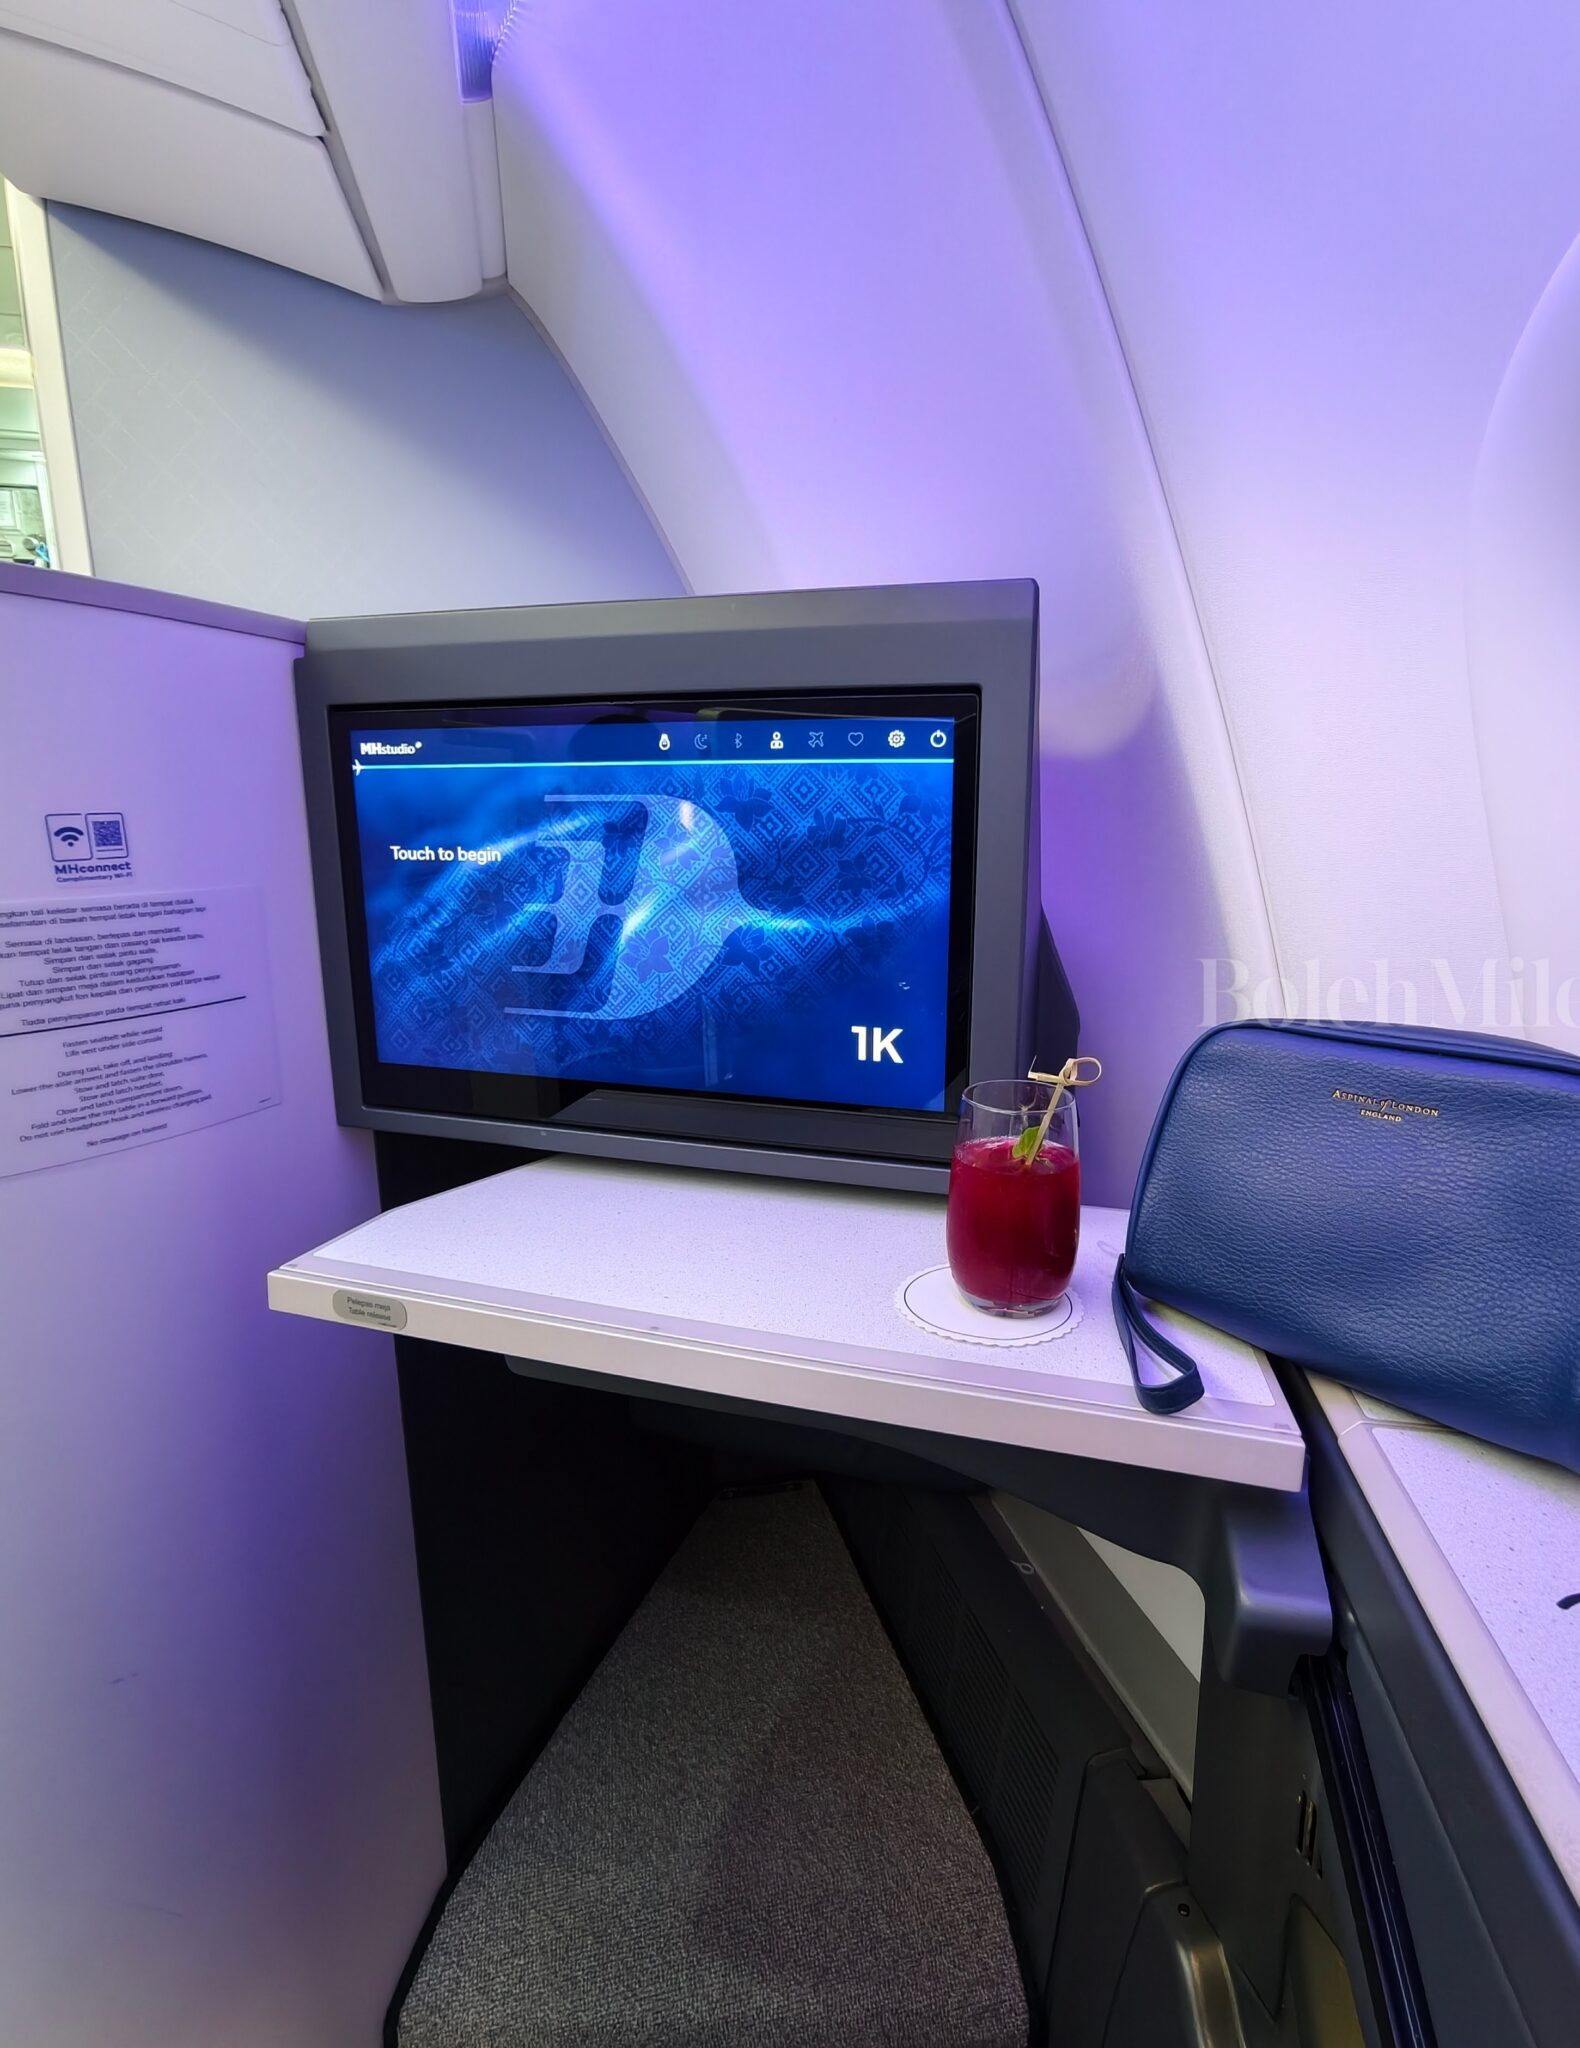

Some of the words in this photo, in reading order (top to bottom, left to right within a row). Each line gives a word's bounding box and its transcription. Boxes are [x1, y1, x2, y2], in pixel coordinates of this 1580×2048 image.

[360, 742, 416, 755] MHstudio
[390, 845, 435, 861] Touch
[438, 847, 454, 861] to
[457, 847, 501, 865] begin
[54, 861, 132, 874] MHconnect
[56, 875, 113, 883] Complimentary
[851, 1025, 904, 1064] 1K
[1332, 1089, 1377, 1105] ASPINAL
[1380, 1099, 1392, 1112] of
[1392, 1101, 1439, 1117] LONDON
[1360, 1109, 1402, 1122] ENGLAND
